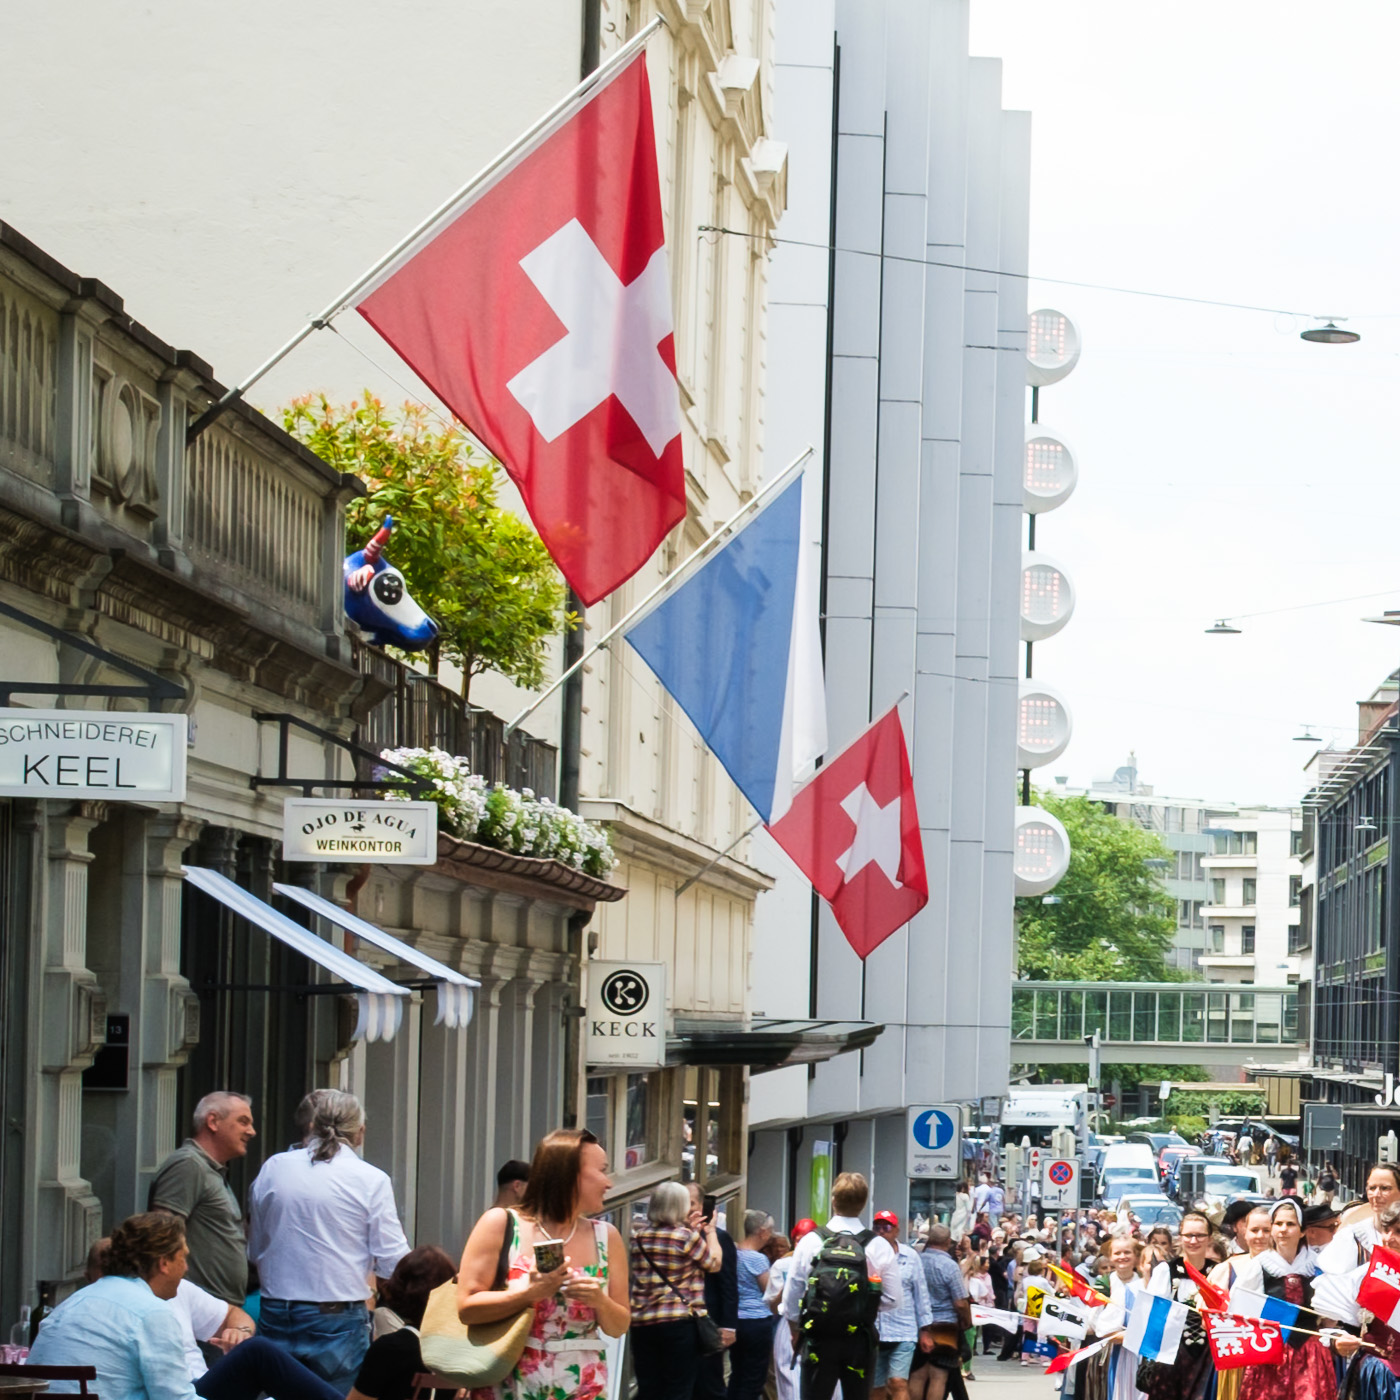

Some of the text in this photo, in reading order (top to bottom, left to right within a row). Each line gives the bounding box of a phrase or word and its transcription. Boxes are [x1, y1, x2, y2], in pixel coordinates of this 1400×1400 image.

[0, 722, 157, 749] SCHNEIDEREI
[24, 754, 137, 788] KEEL
[302, 811, 417, 839] OJO DE AGUA
[316, 839, 402, 853] WEINKONTOR
[110, 1025, 122, 1034] 13
[592, 1021, 656, 1037] KECK
